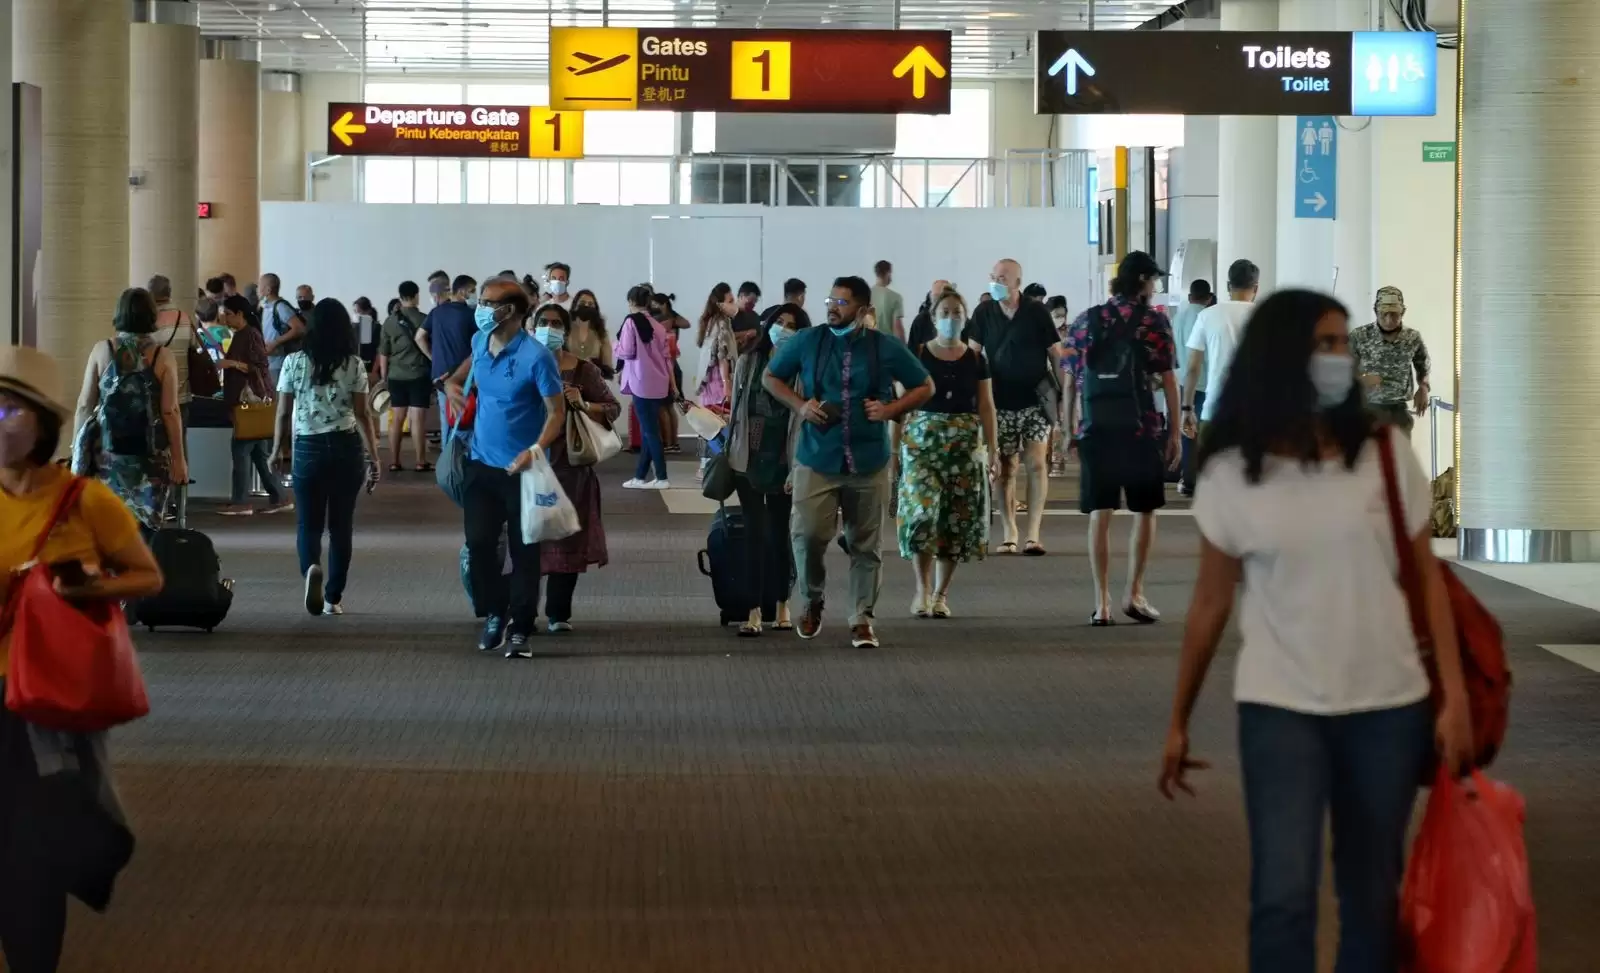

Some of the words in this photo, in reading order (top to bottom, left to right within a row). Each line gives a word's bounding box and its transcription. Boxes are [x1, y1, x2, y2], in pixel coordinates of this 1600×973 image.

[642, 36, 708, 56] Gates
[1242, 46, 1331, 69] Toilets
[641, 63, 690, 81] Pintu
[752, 50, 770, 92] 1
[1281, 76, 1330, 91] Toilet
[642, 86, 686, 102] 登机口
[364, 105, 467, 128] Departure
[470, 107, 520, 126] Gate
[395, 127, 427, 140] Pintu
[429, 127, 520, 143] Keberangkatan
[544, 112, 561, 152] 1
[1429, 151, 1448, 159] EXIT
